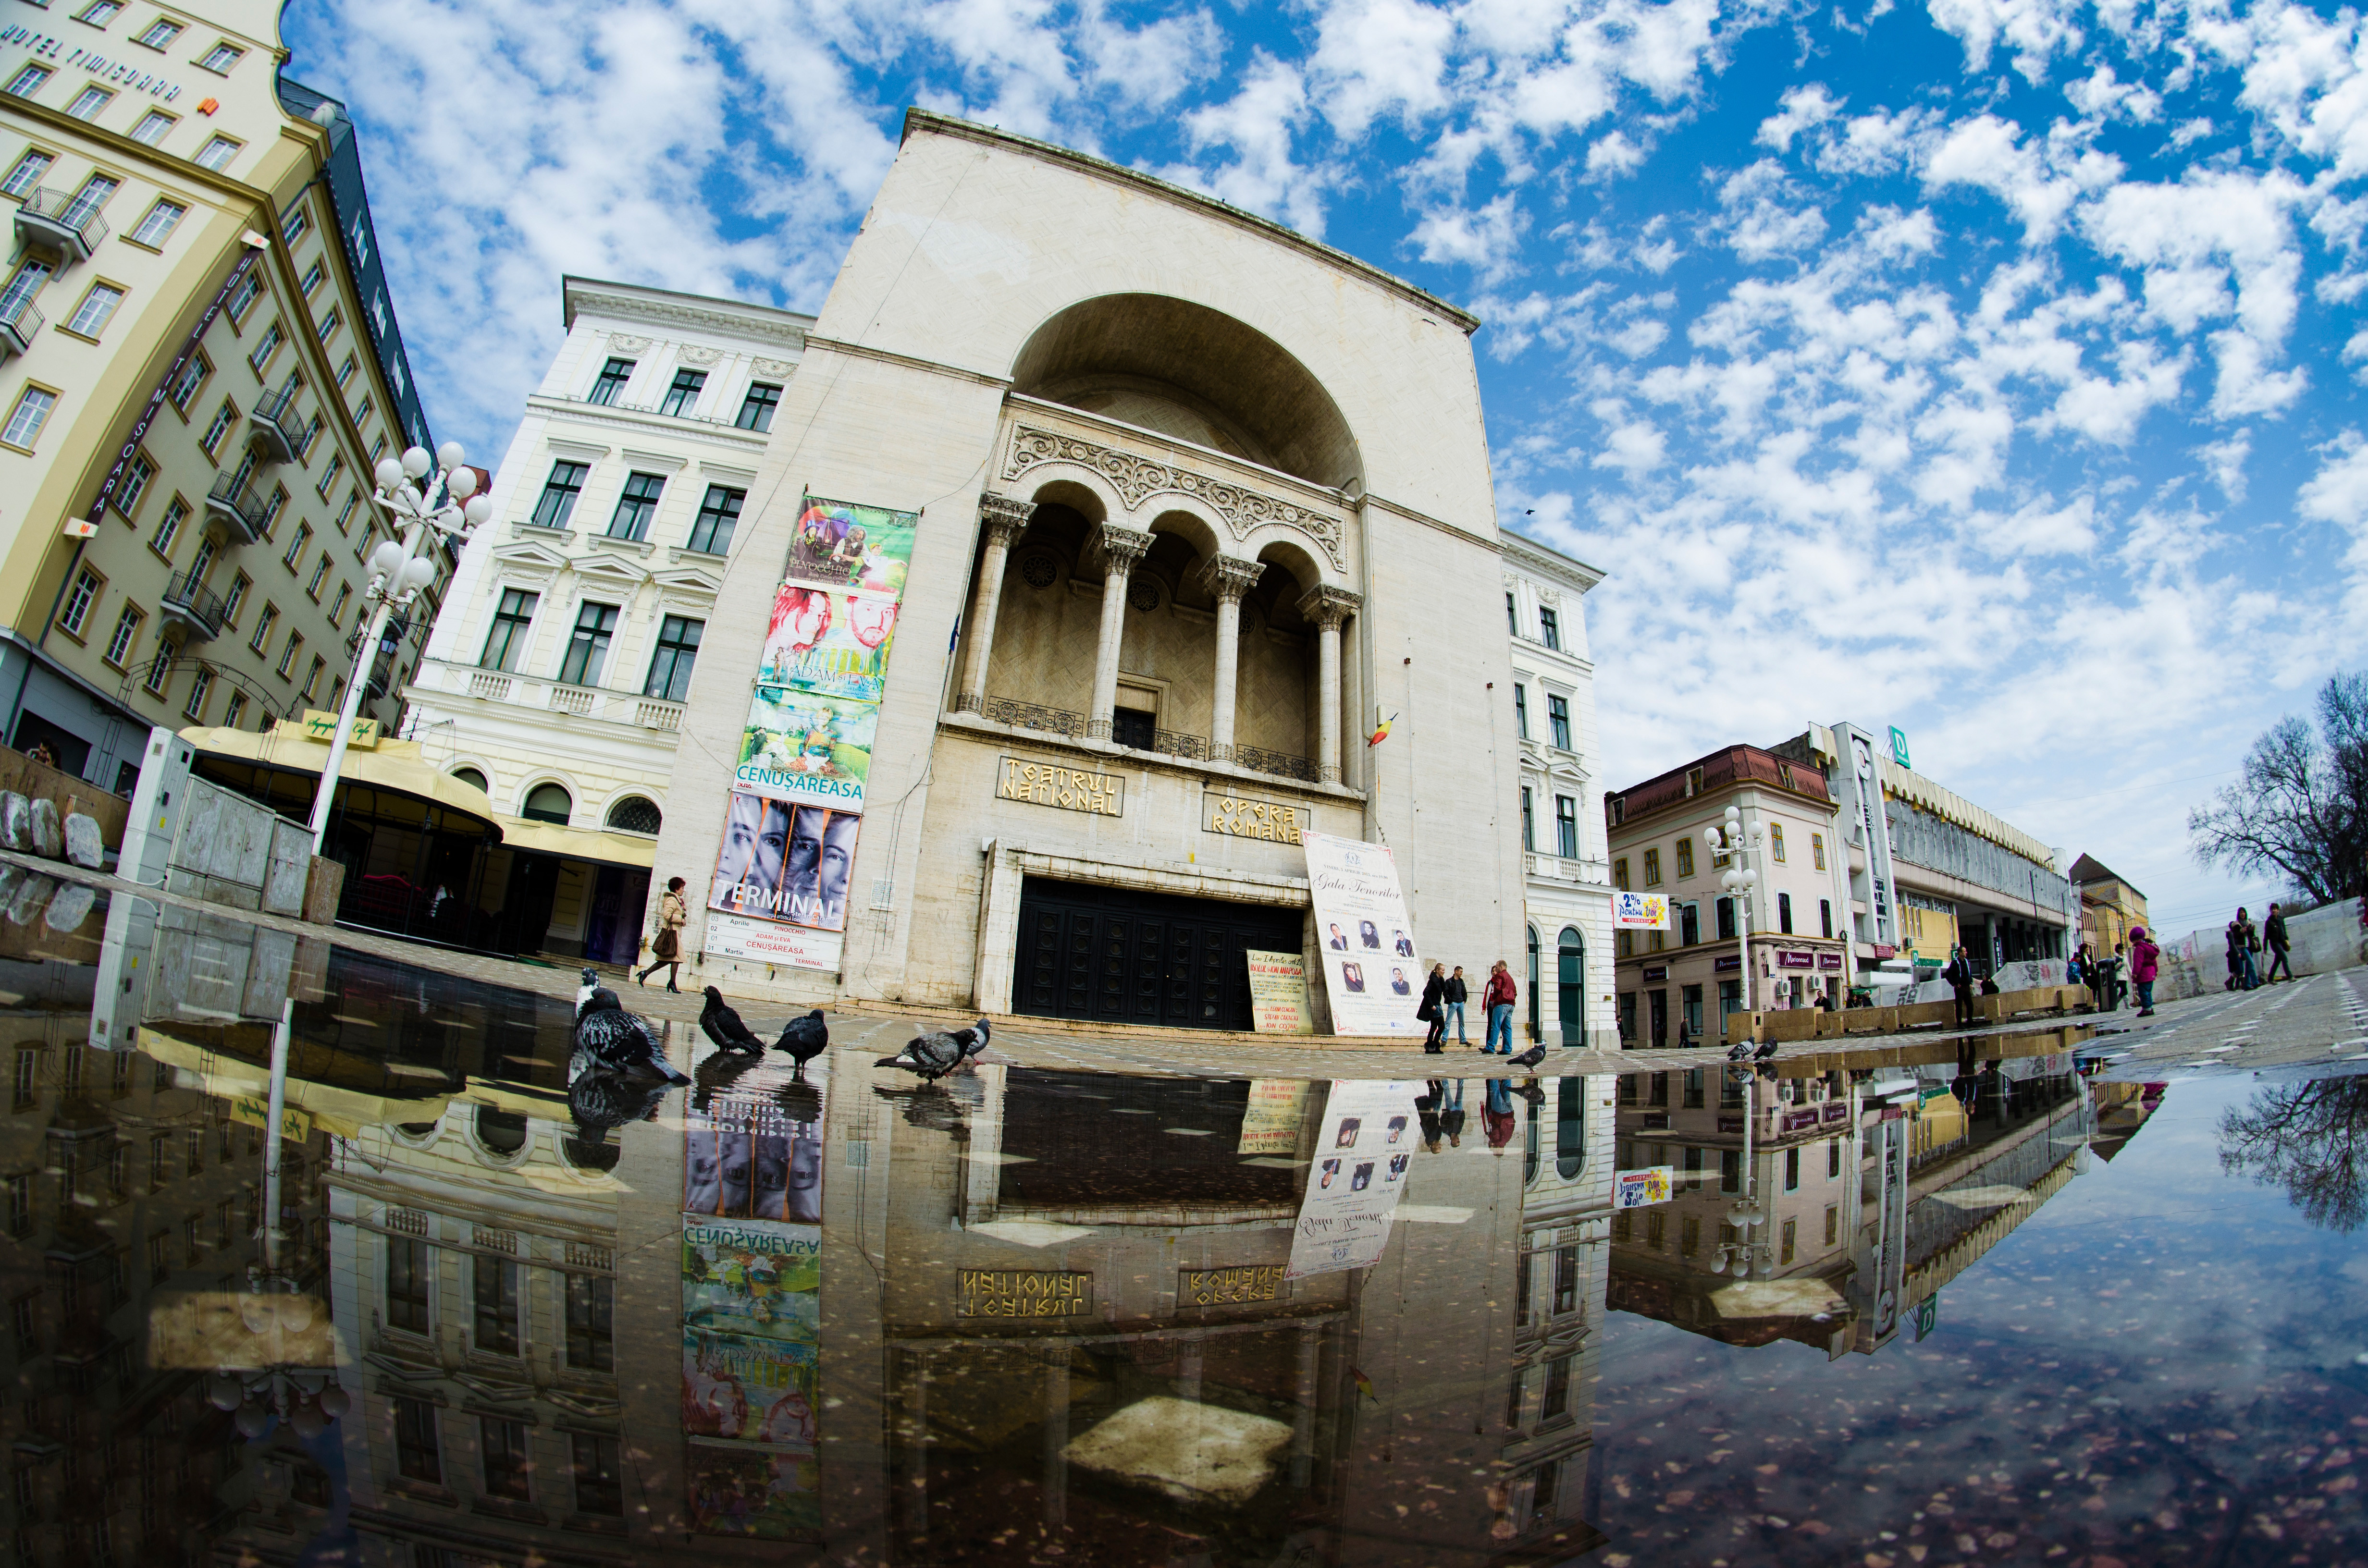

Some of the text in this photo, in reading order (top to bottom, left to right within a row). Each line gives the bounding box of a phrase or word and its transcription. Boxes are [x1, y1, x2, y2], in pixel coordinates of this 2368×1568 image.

[0, 23, 63, 58] HOTEL
[193, 257, 252, 338] HOTEL
[789, 558, 851, 576] PINOCCHIO
[789, 665, 836, 682] ADAM
[848, 674, 879, 689] EVA
[1001, 778, 1118, 815] NATIONAL
[1221, 796, 1295, 823] OPERA
[1212, 814, 1300, 844] ROMANA
[1313, 870, 1400, 899] Gala Tenorilor
[718, 879, 839, 919] TERMINAL
[1619, 904, 1657, 918] Pentru Voi
[1623, 894, 1640, 907] 2%
[730, 919, 750, 927] Aprilie
[774, 926, 806, 935] PINOCCHIO
[725, 947, 744, 956] Martie
[795, 958, 824, 967] TERMINAL
[1785, 952, 1809, 966] Marionnaud
